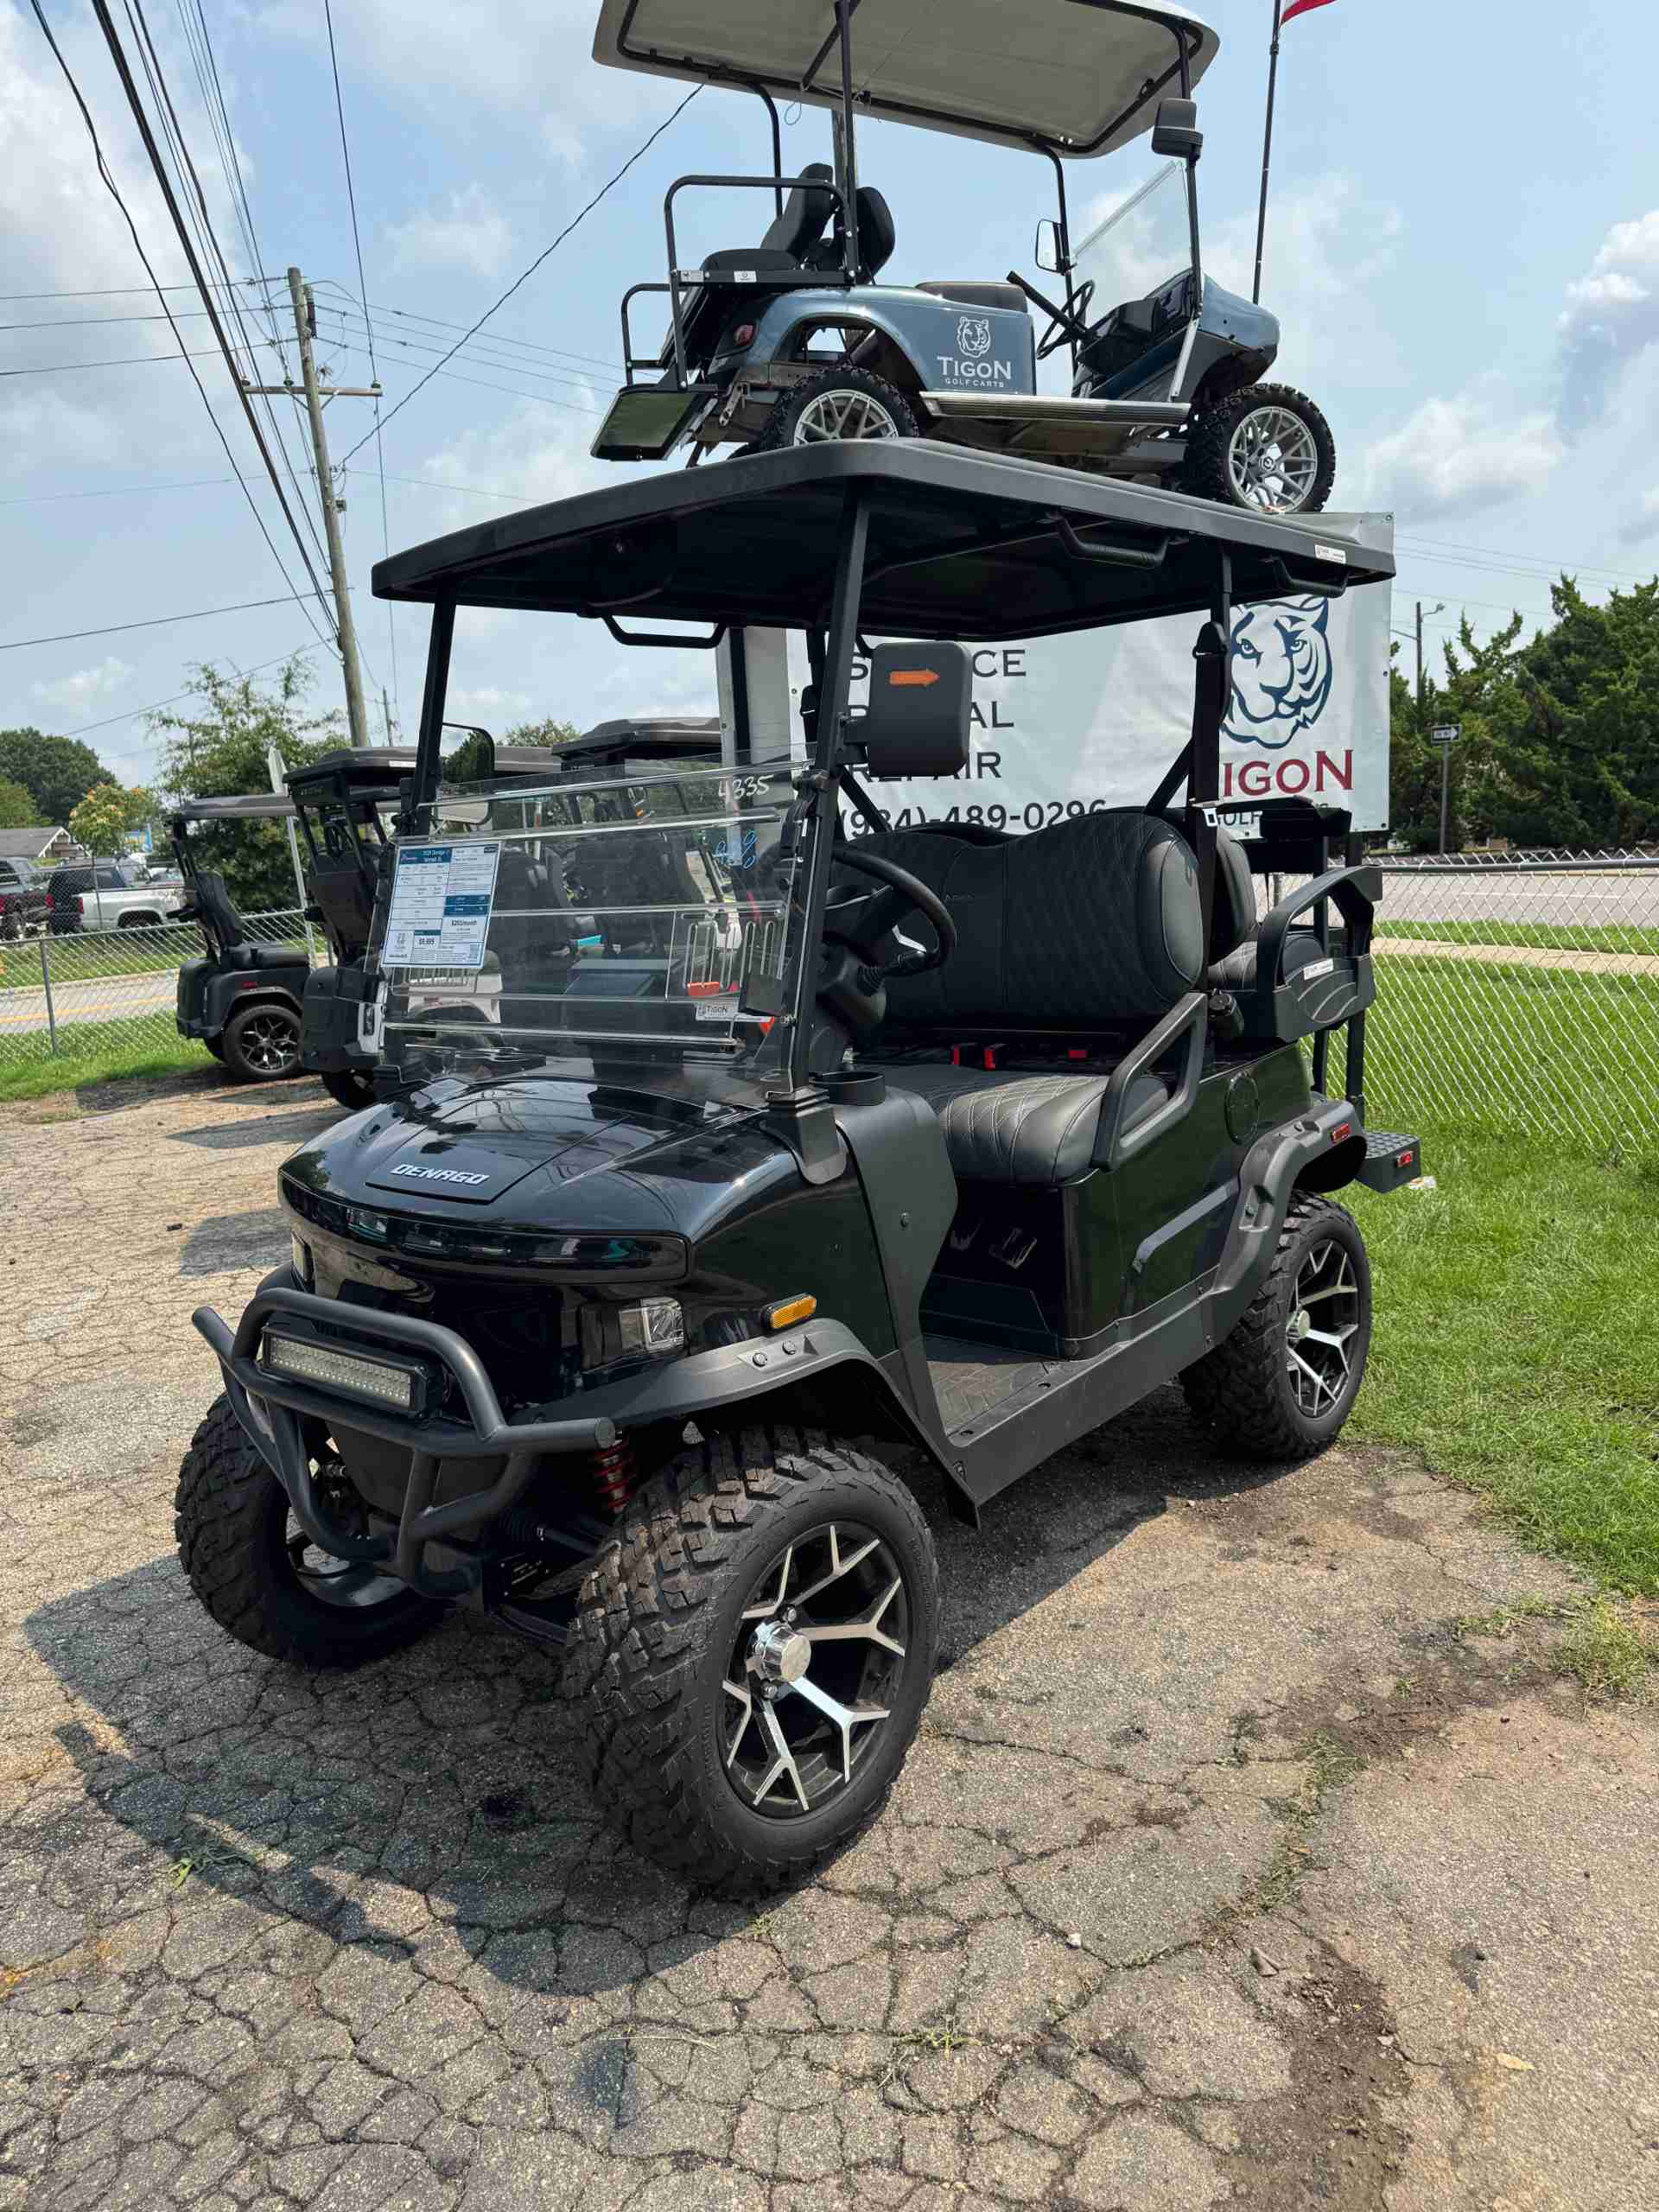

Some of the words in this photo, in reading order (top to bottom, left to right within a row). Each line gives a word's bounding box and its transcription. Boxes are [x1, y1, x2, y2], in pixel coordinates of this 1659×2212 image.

[937, 356, 1012, 380] TIGON
[945, 378, 969, 386] GOLF
[972, 379, 1004, 388] CARTS
[1223, 749, 1353, 797] IGON
[390, 1164, 490, 1185] DENAGO
